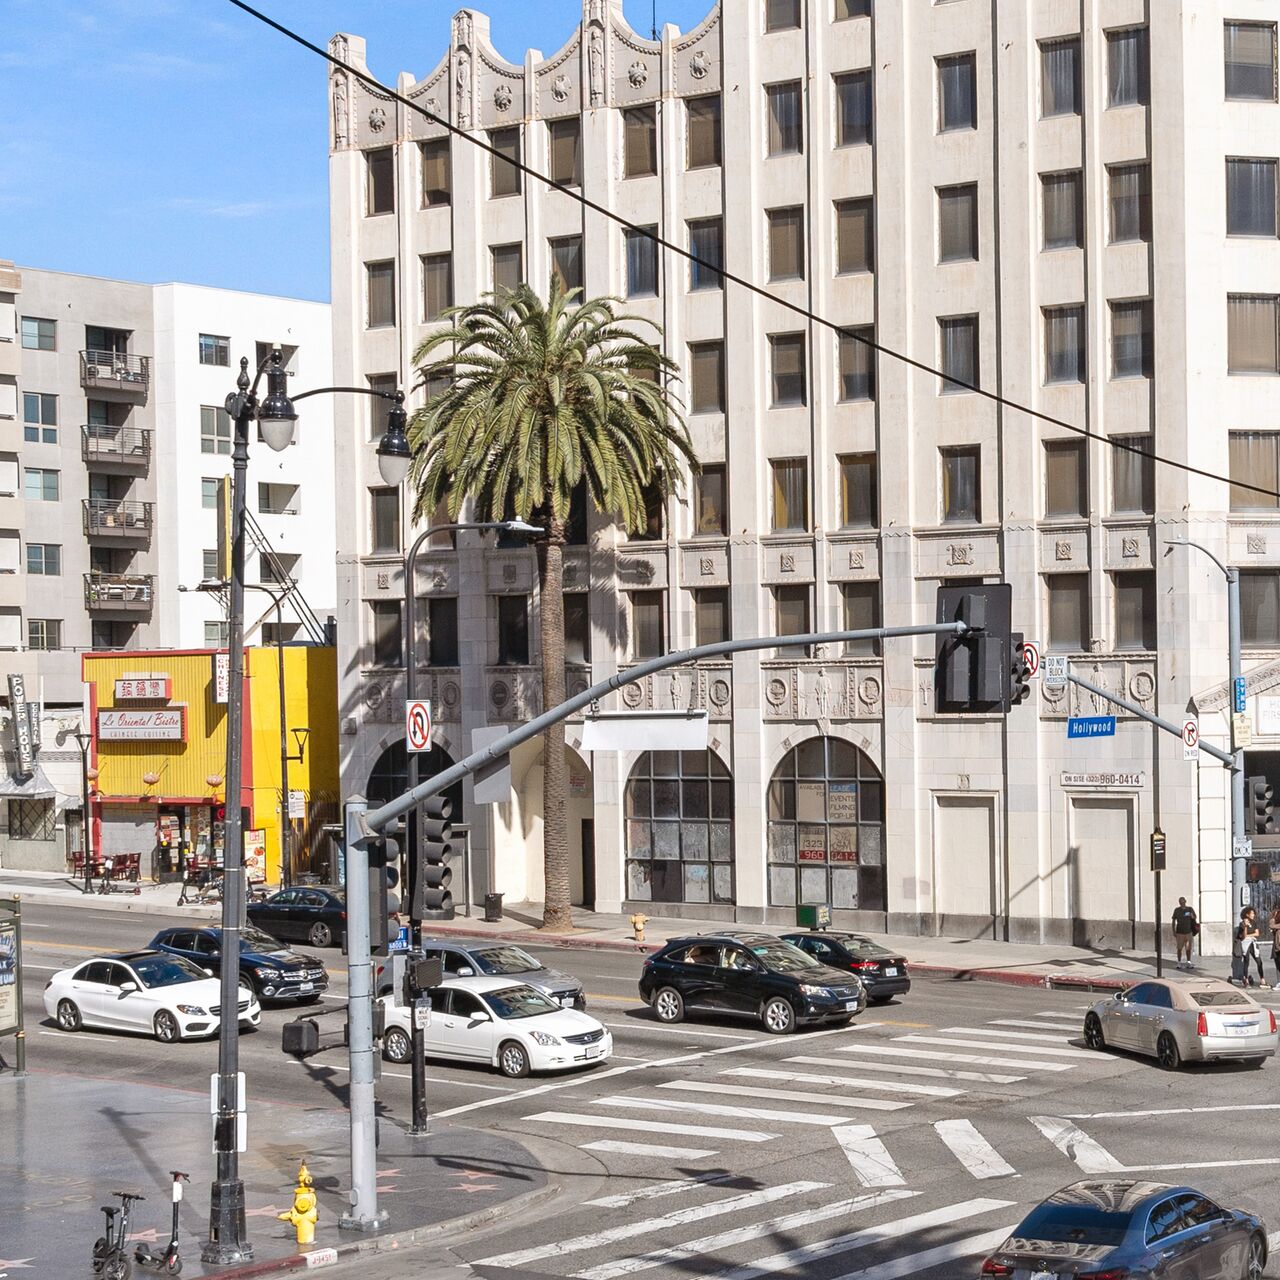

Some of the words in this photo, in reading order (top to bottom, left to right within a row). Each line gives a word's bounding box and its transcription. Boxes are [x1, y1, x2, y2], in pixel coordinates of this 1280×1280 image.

[1048, 658, 1056, 666] DO
[1056, 657, 1065, 666] NOT
[13, 677, 27, 722] POWER
[117, 712, 153, 726] Oriental
[1073, 721, 1111, 735] Hollywood
[19, 726, 31, 771] HOUSE
[805, 851, 824, 859] 960
